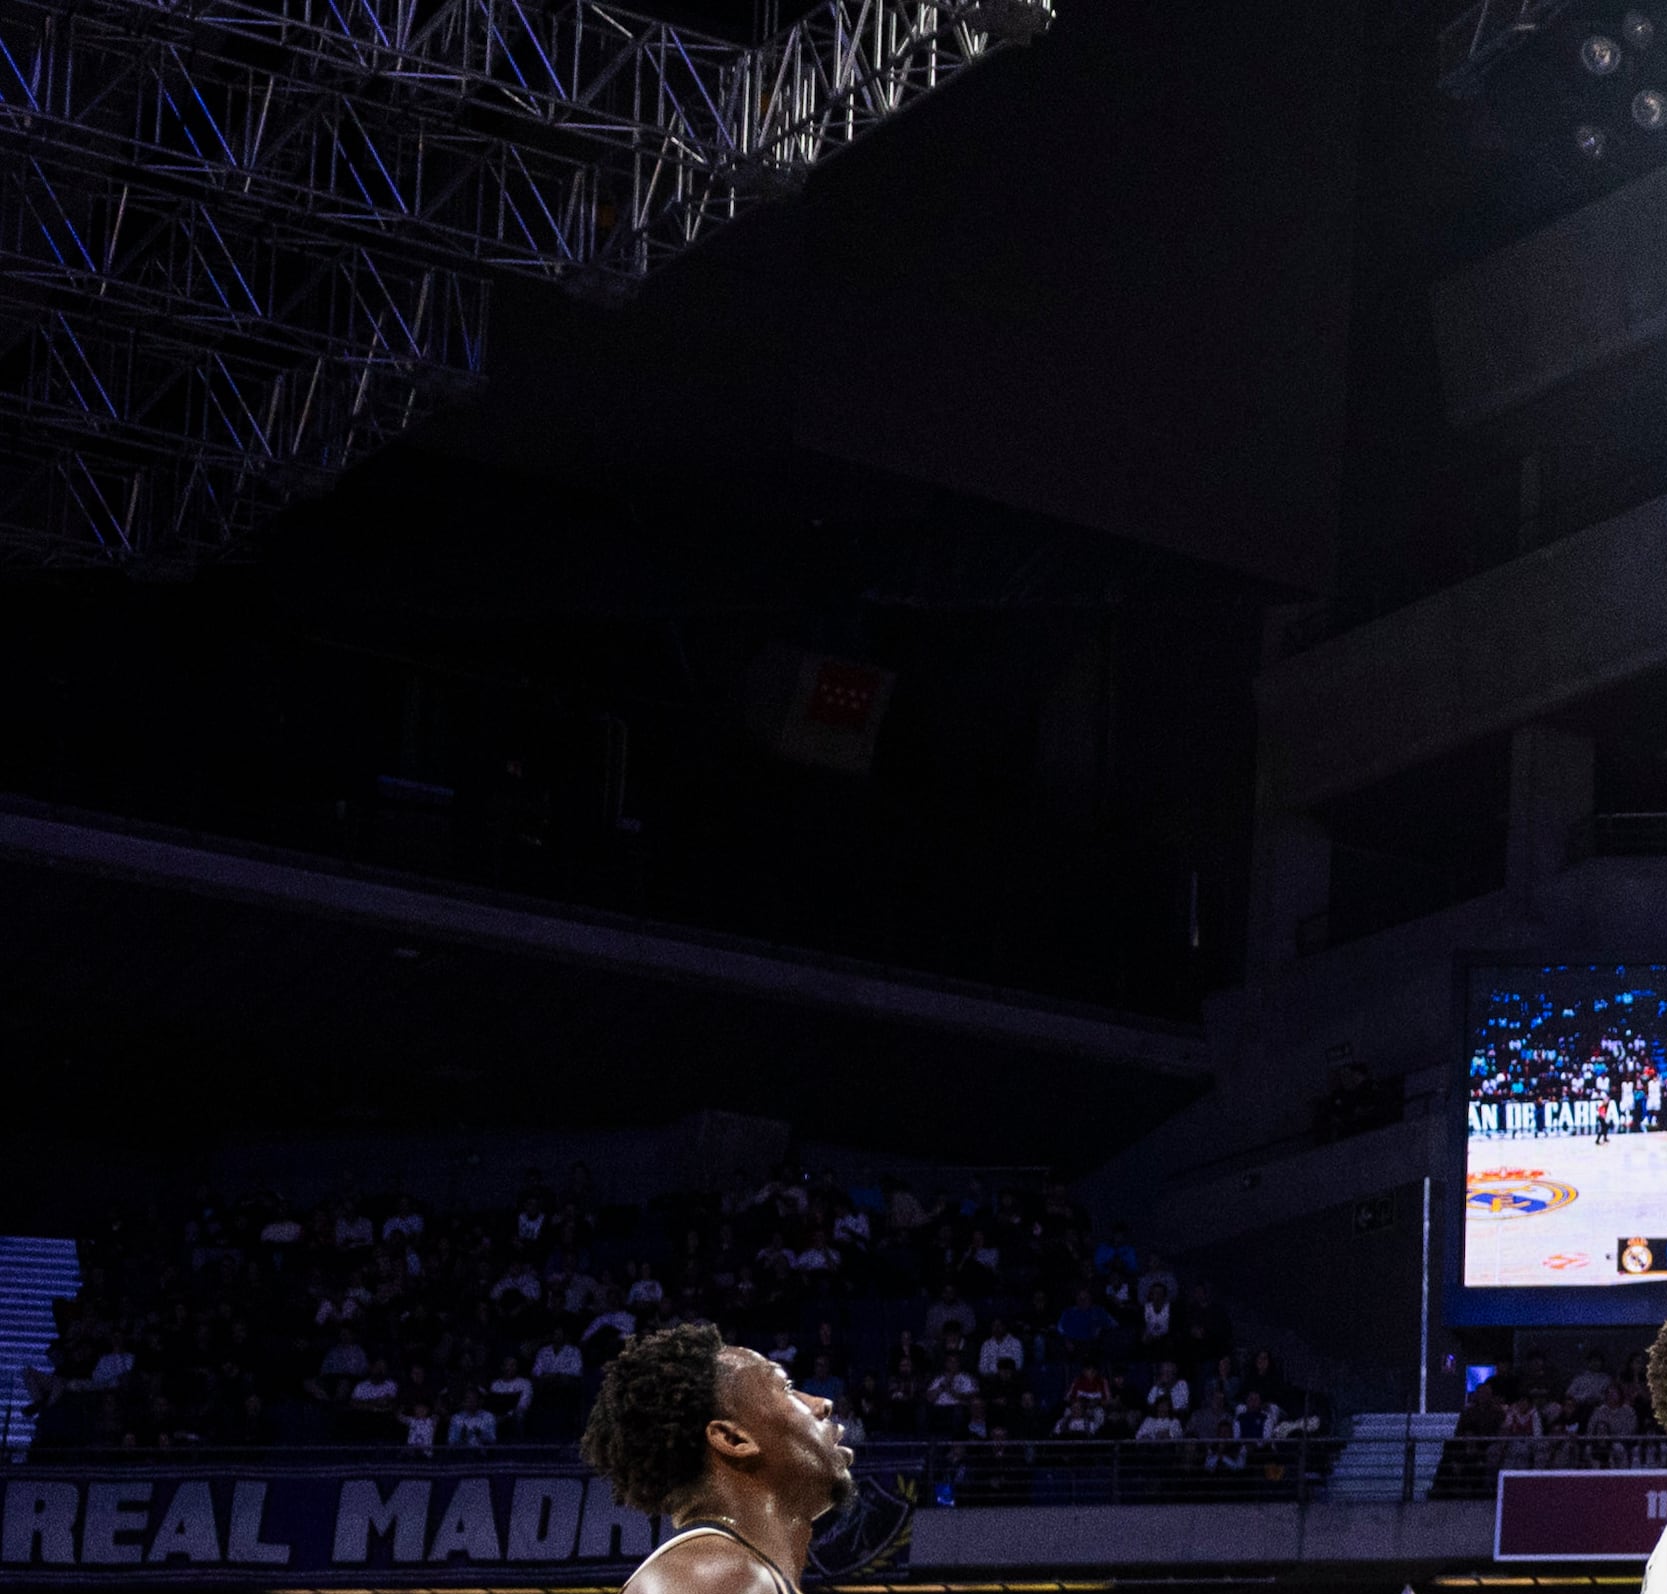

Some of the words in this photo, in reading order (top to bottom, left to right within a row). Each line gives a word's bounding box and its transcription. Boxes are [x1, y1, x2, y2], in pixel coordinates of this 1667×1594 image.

[1544, 1099, 1622, 1128] CABRA
[0, 1478, 291, 1564] REAL
[331, 1478, 668, 1564] MADR
